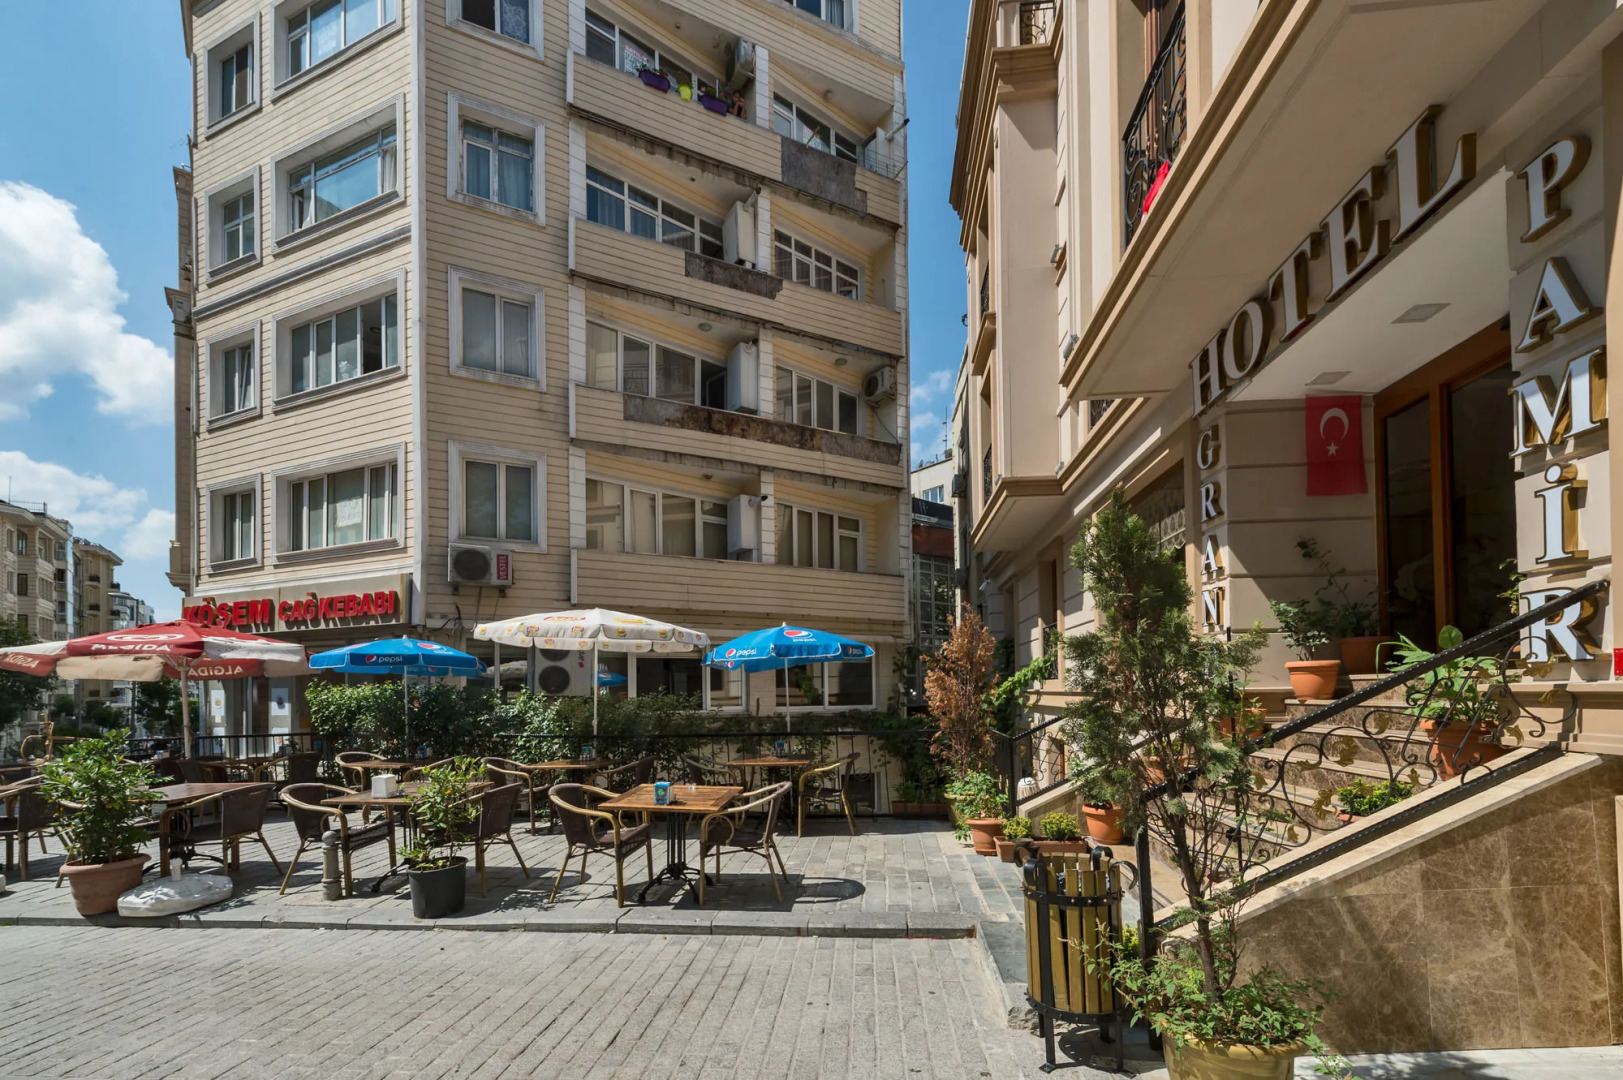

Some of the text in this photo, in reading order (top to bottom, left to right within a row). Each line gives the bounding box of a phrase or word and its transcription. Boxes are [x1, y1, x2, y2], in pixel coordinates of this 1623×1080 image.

[1189, 104, 1477, 418] HOTEL
[318, 590, 395, 619] KEBABI
[379, 655, 403, 663] pepsi
[736, 648, 757, 657] pepsi
